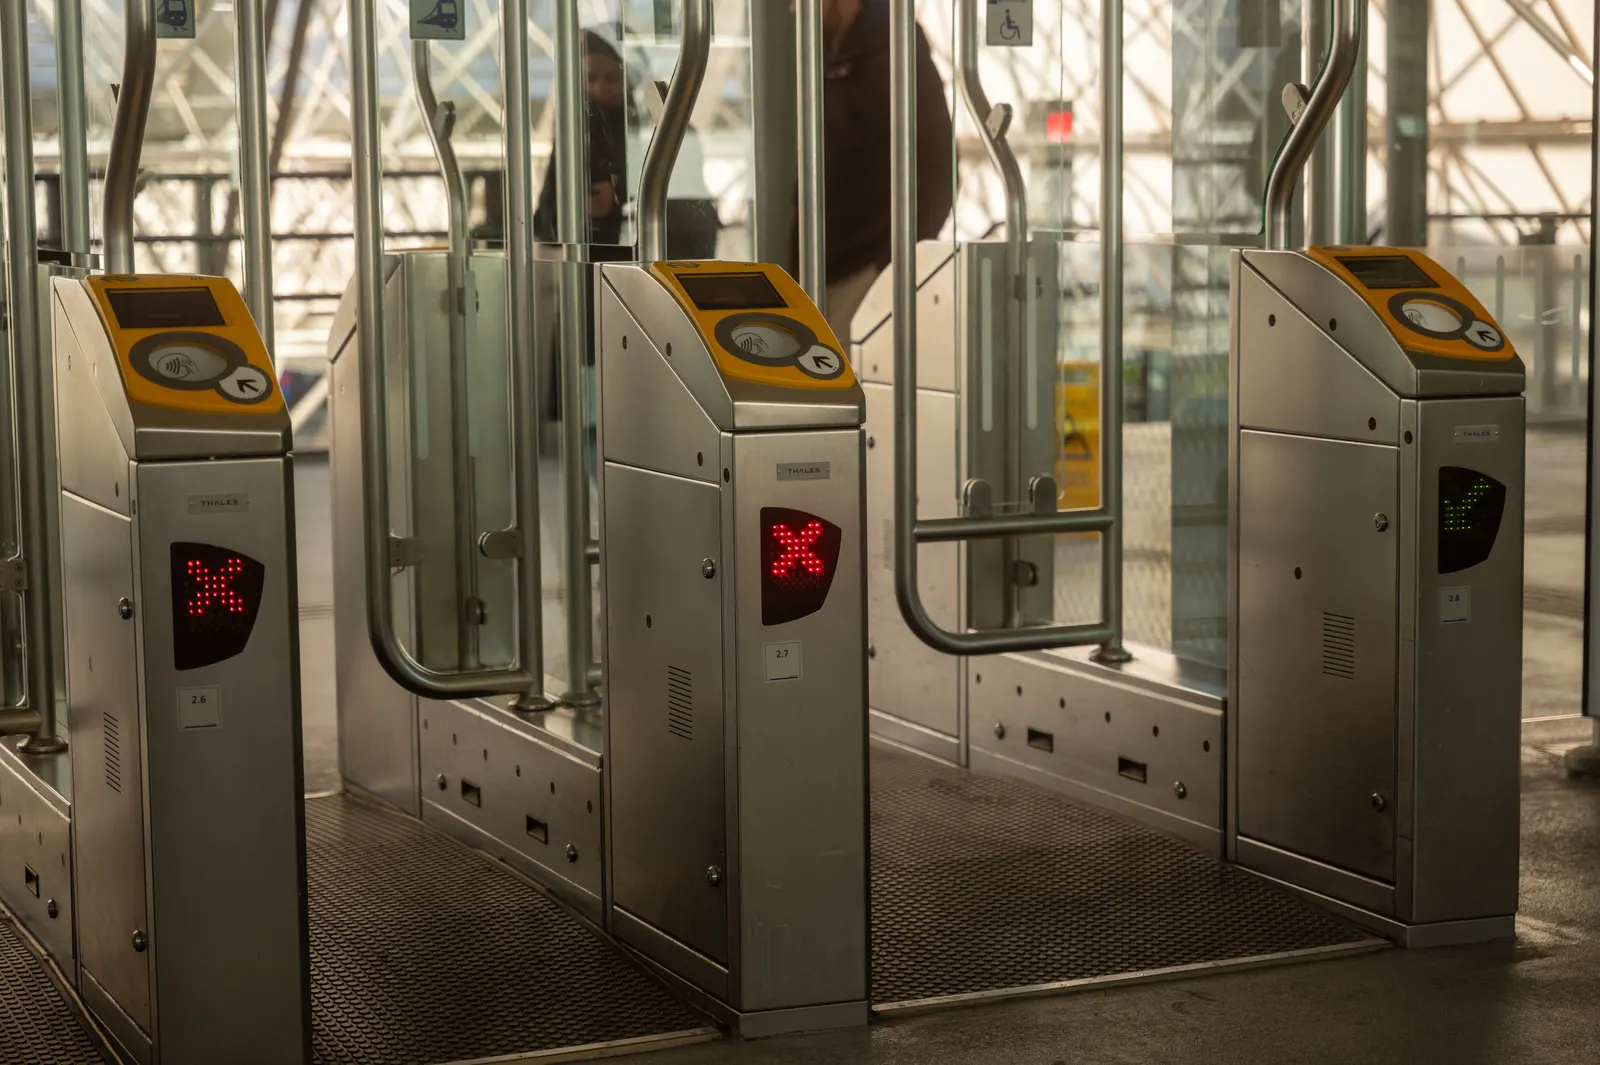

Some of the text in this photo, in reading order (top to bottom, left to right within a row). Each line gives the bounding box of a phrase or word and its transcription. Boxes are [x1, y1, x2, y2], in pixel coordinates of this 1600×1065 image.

[1448, 594, 1460, 602] 2.8
[775, 649, 789, 659] 2.7
[190, 695, 207, 705] 2.6
